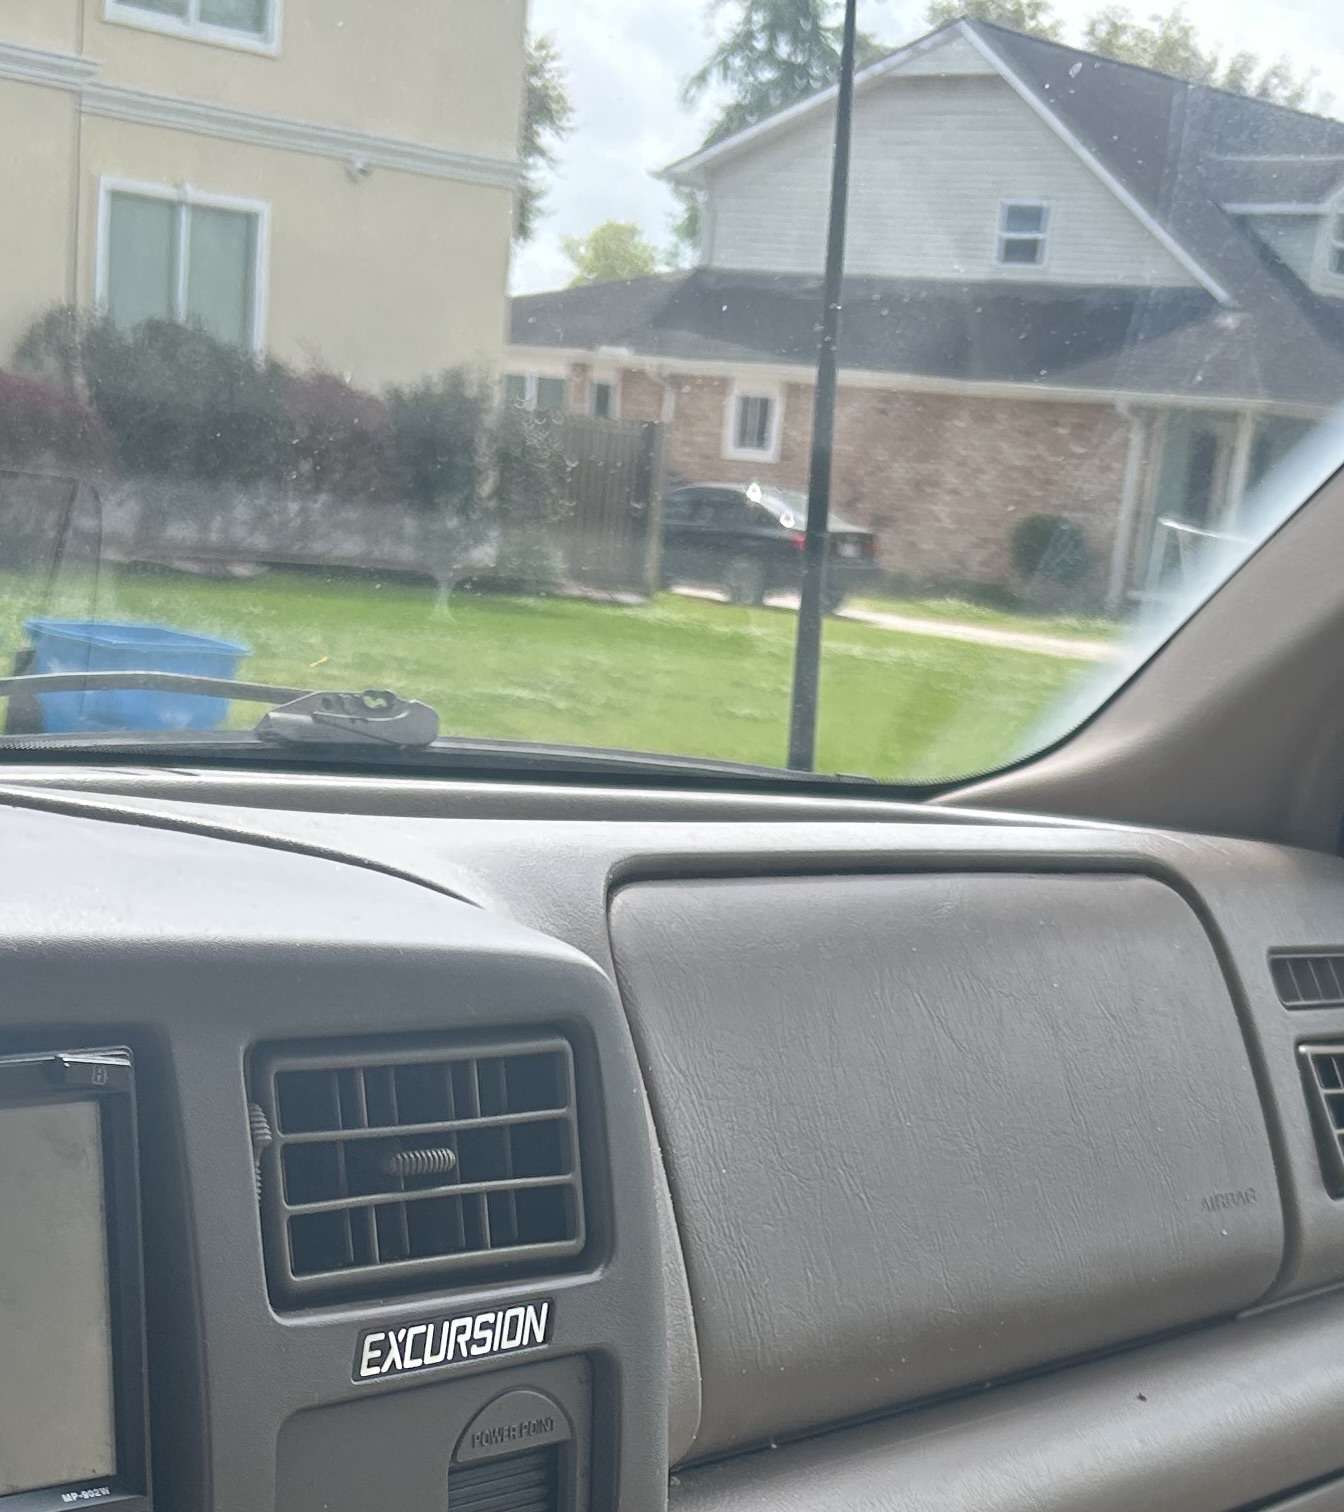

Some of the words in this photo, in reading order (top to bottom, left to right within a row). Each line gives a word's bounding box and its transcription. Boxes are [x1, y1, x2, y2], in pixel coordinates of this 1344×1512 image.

[360, 1302, 549, 1377] EXCURSION
[471, 1425, 517, 1449] POWER
[519, 1416, 555, 1439] POINT
